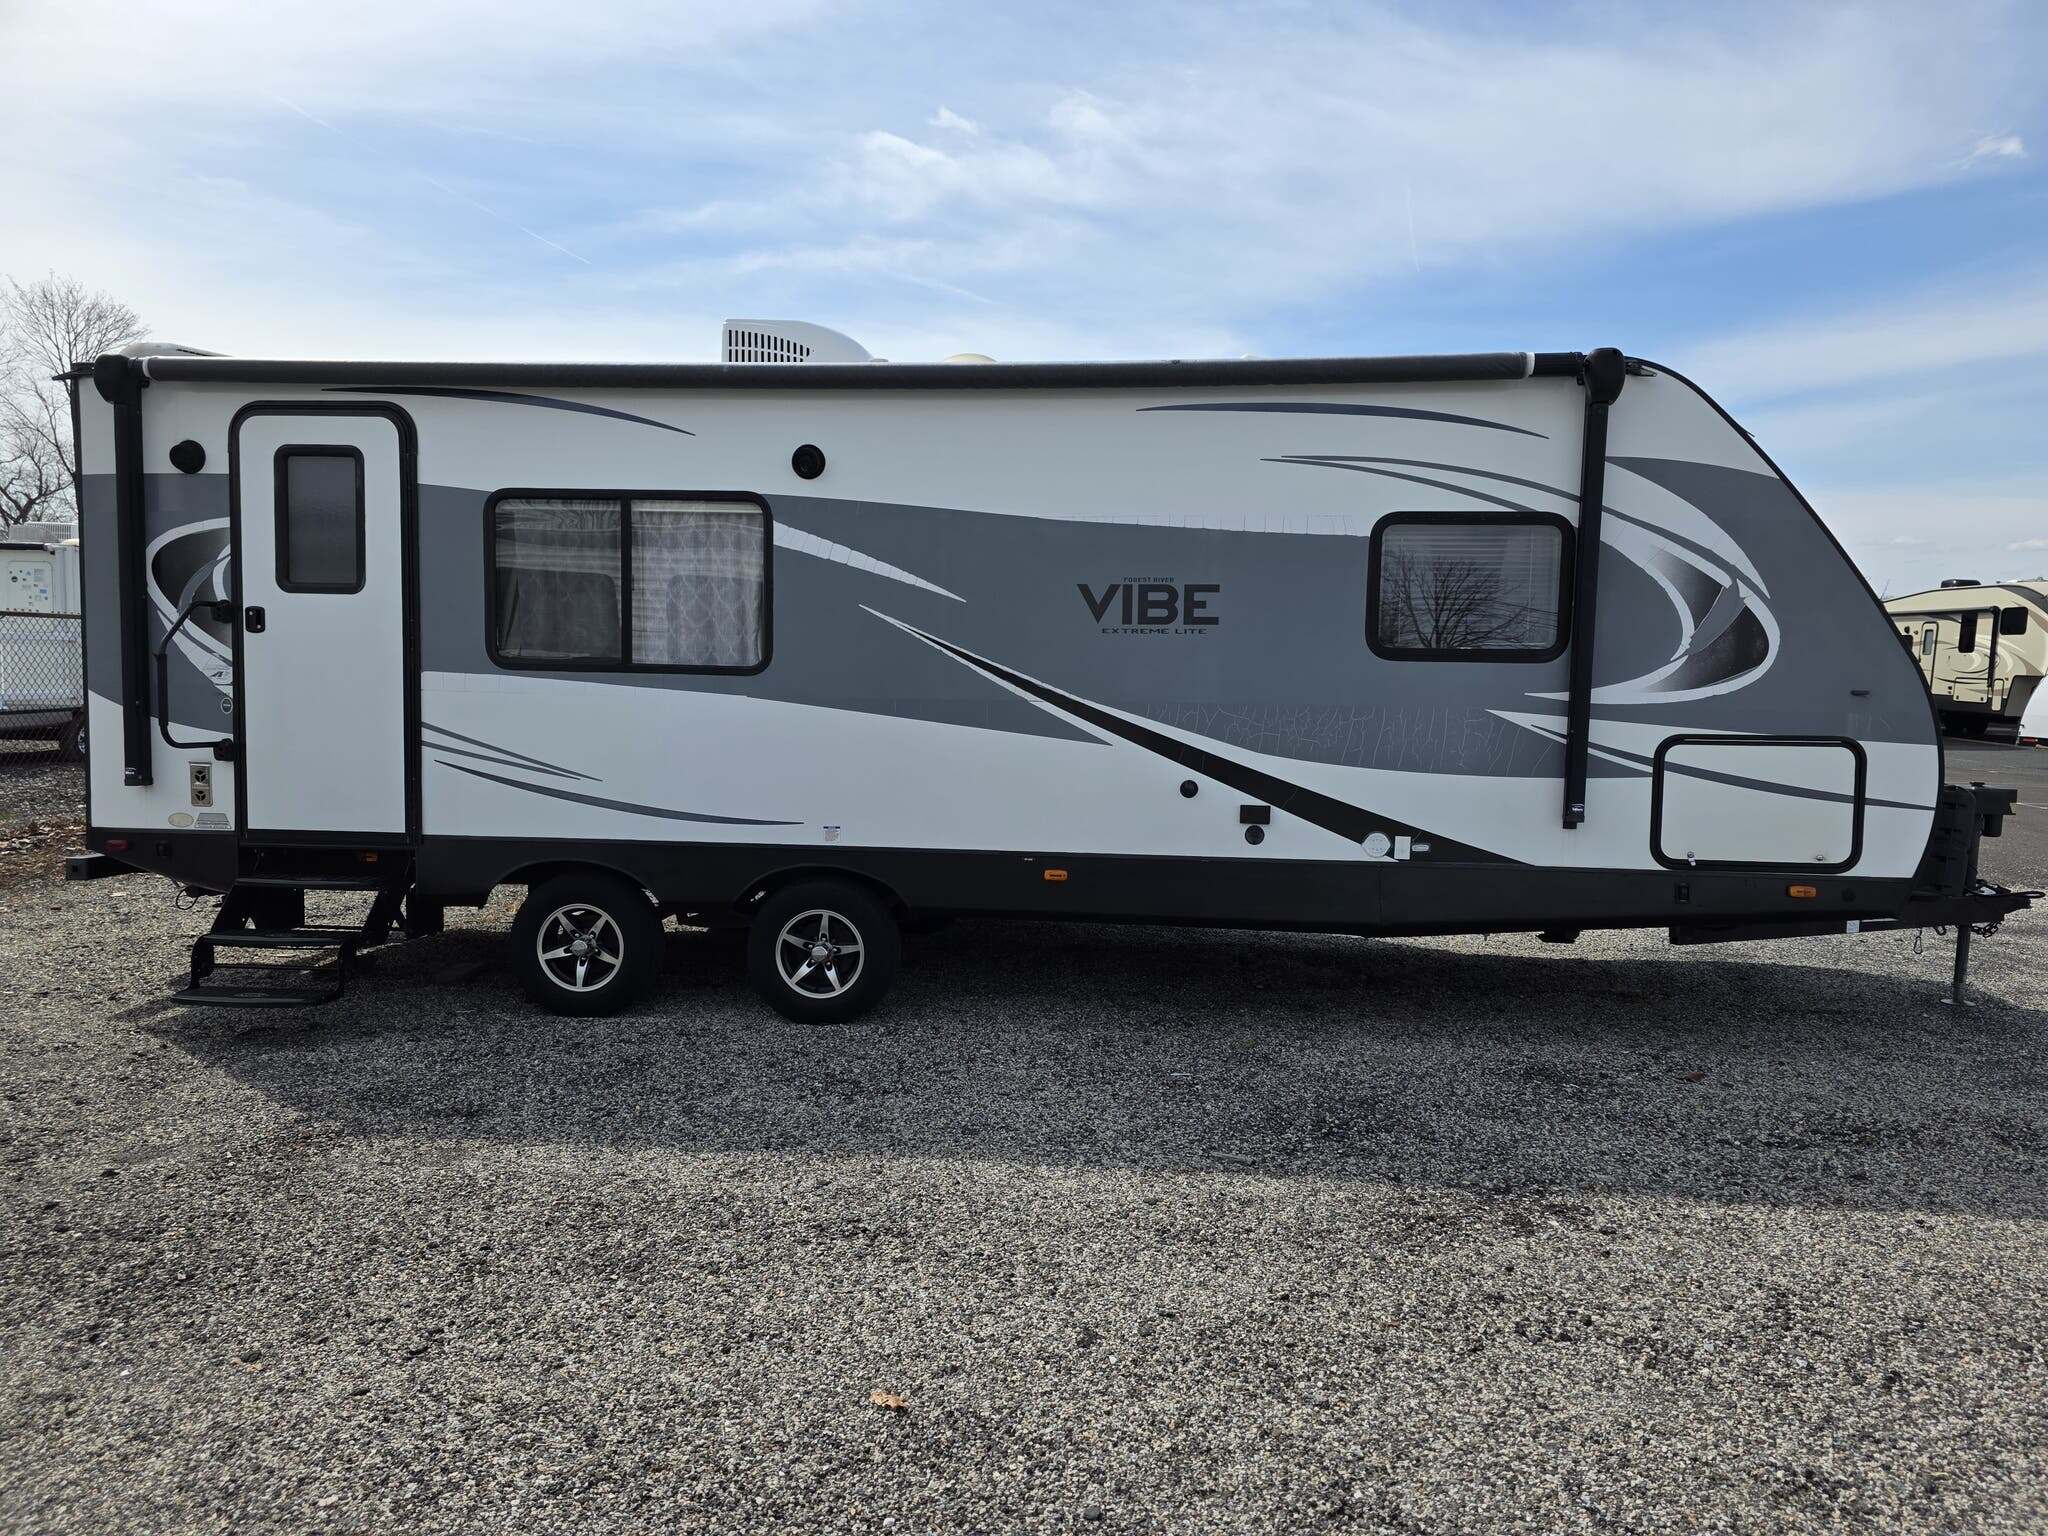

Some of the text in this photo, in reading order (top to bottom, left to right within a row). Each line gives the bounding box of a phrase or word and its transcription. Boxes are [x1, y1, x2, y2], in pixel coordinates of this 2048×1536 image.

[1076, 583, 1220, 626] VIBE
[1101, 627, 1208, 635] EXTREME LITE
